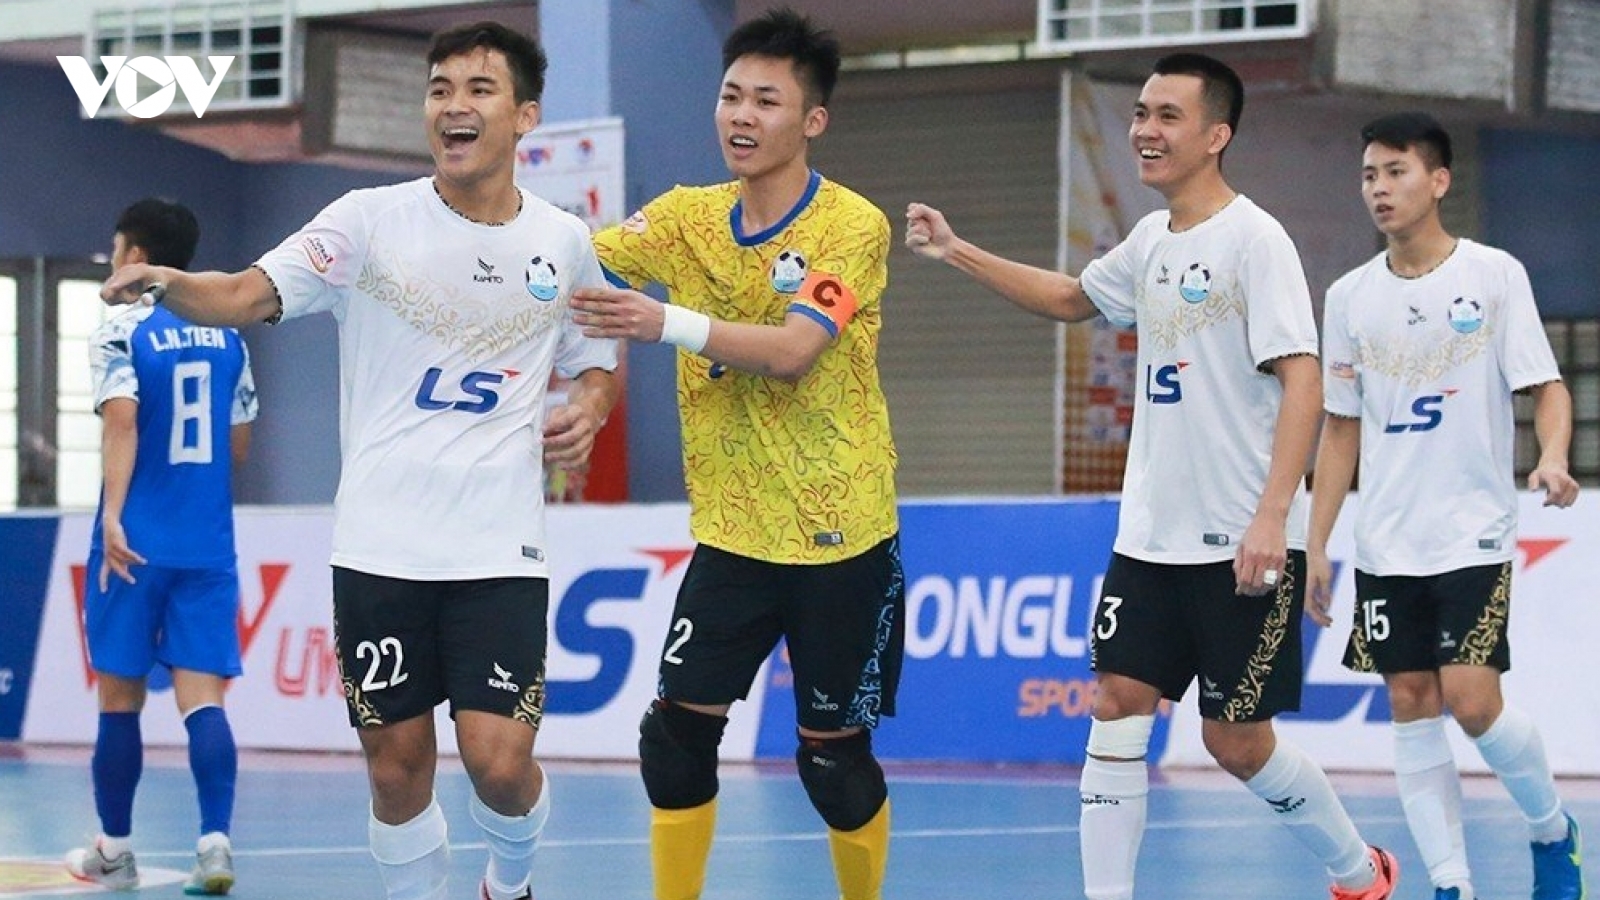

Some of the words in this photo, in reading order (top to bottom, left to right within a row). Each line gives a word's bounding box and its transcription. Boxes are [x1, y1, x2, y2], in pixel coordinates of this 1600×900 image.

[812, 280, 842, 308] C
[169, 361, 213, 465] 8
[414, 367, 503, 414] LS
[663, 617, 694, 665] 2
[1096, 596, 1123, 640] 3
[1361, 599, 1391, 643] 15
[356, 636, 409, 692] 22
